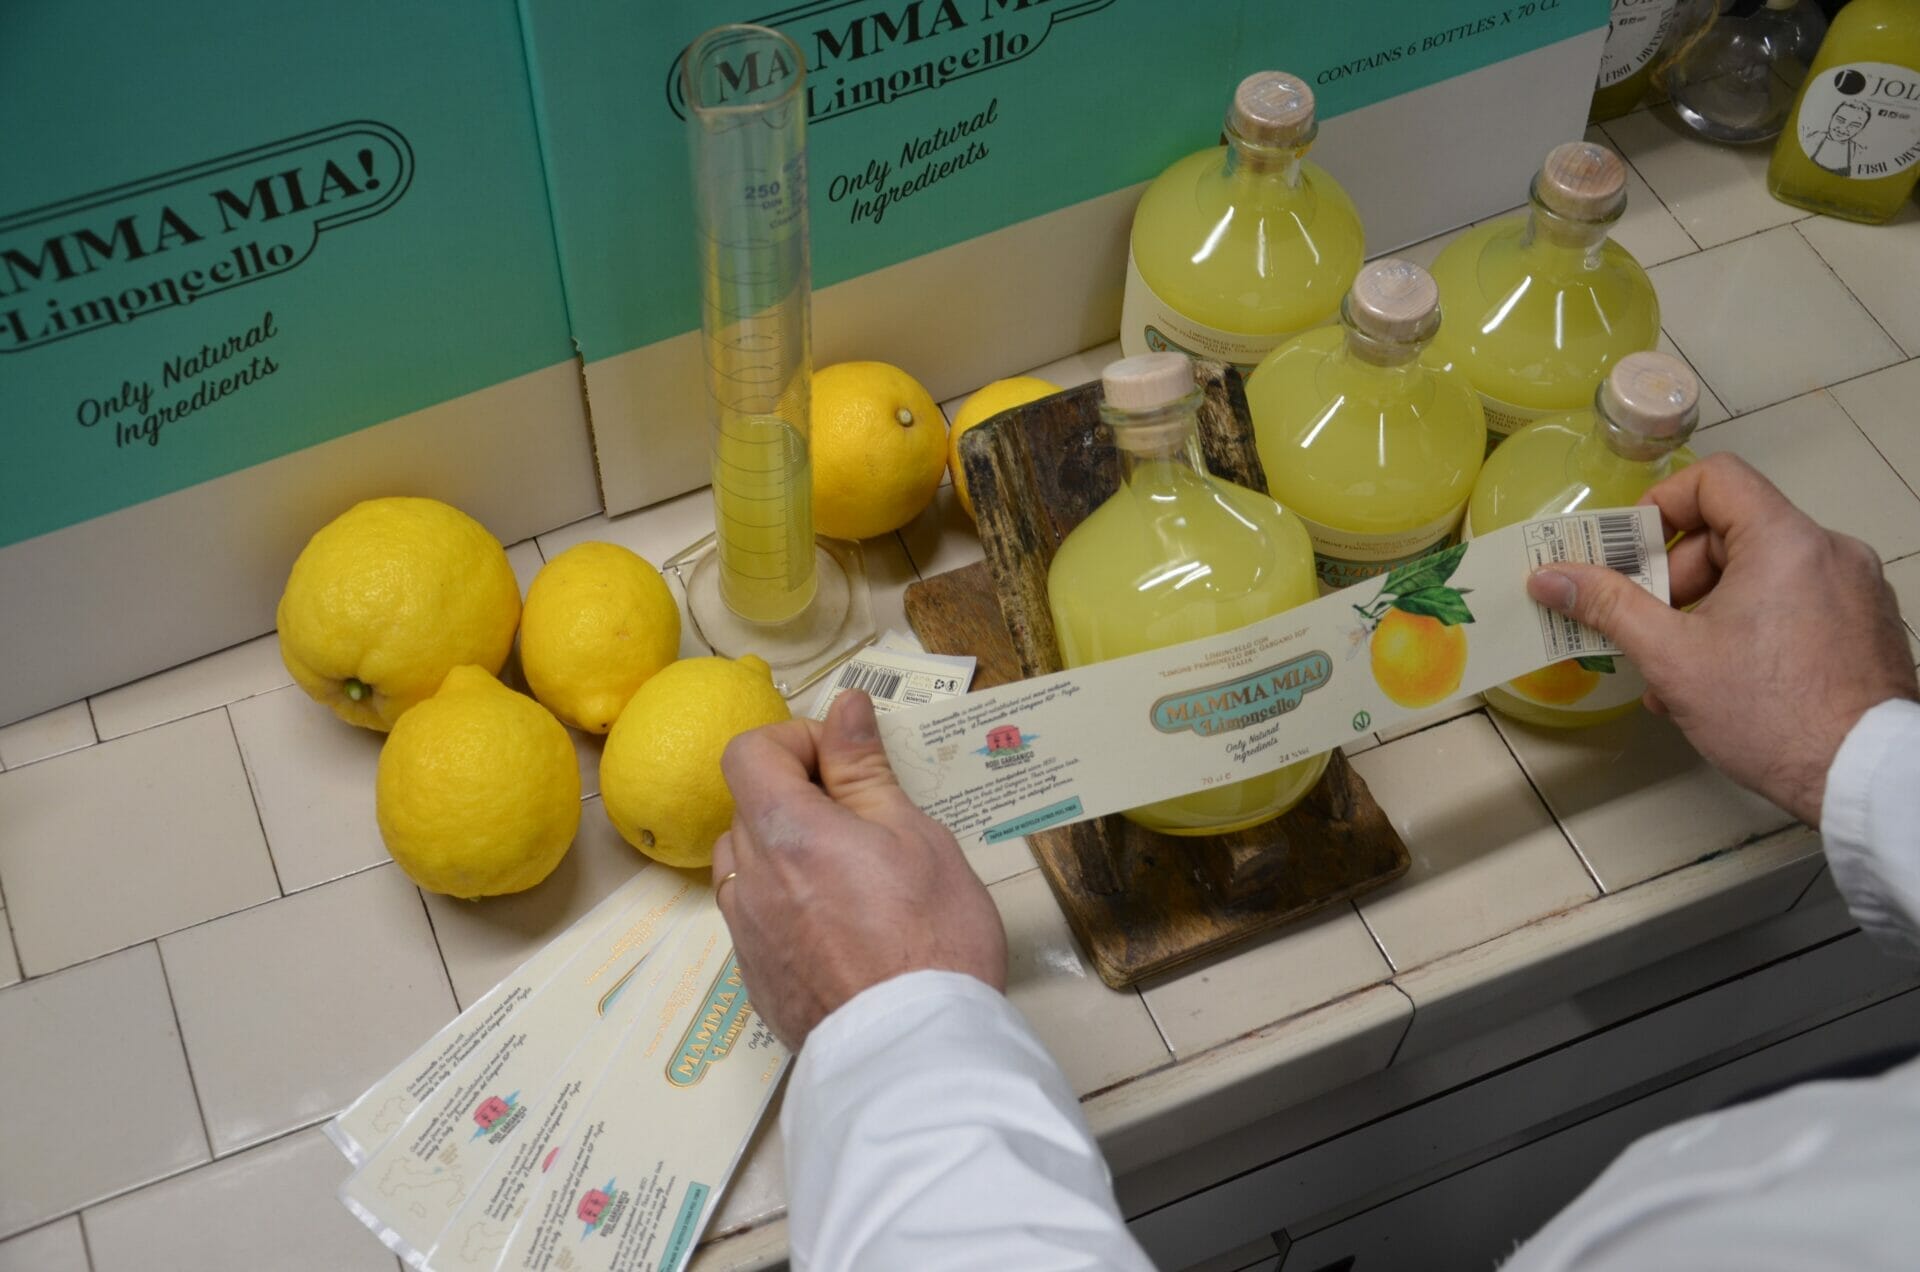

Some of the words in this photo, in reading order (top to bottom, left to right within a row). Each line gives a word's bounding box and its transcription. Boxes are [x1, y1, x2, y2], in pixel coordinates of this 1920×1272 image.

[807, 30, 1030, 119] Limoncello
[1316, 47, 1402, 86] CONTAINS
[1406, 42, 1416, 56] 6
[1422, 16, 1496, 52] BOTTLES
[1500, 11, 1512, 25] X
[1517, 2, 1536, 20] 70
[1871, 77, 1920, 101] JOI
[744, 181, 780, 200] 250
[828, 159, 891, 202] Only
[900, 98, 998, 169] Natural
[851, 140, 989, 224] Ingredients
[0, 205, 205, 298] MMA
[209, 148, 381, 234] MIA!
[0, 241, 294, 345] Limoncello
[77, 381, 154, 428] Only
[163, 311, 279, 388] Natural
[116, 356, 280, 448] Ingredients
[1165, 683, 1269, 724] MAMMA
[1271, 661, 1324, 694] MIA!
[1198, 697, 1296, 737] Limoncello
[1225, 739, 1247, 753] Only
[1249, 722, 1279, 744] Natural
[1230, 737, 1278, 763] Ingredients
[1279, 752, 1290, 763] 24
[679, 989, 738, 1078] MAMMA
[711, 1002, 751, 1060] Limon
